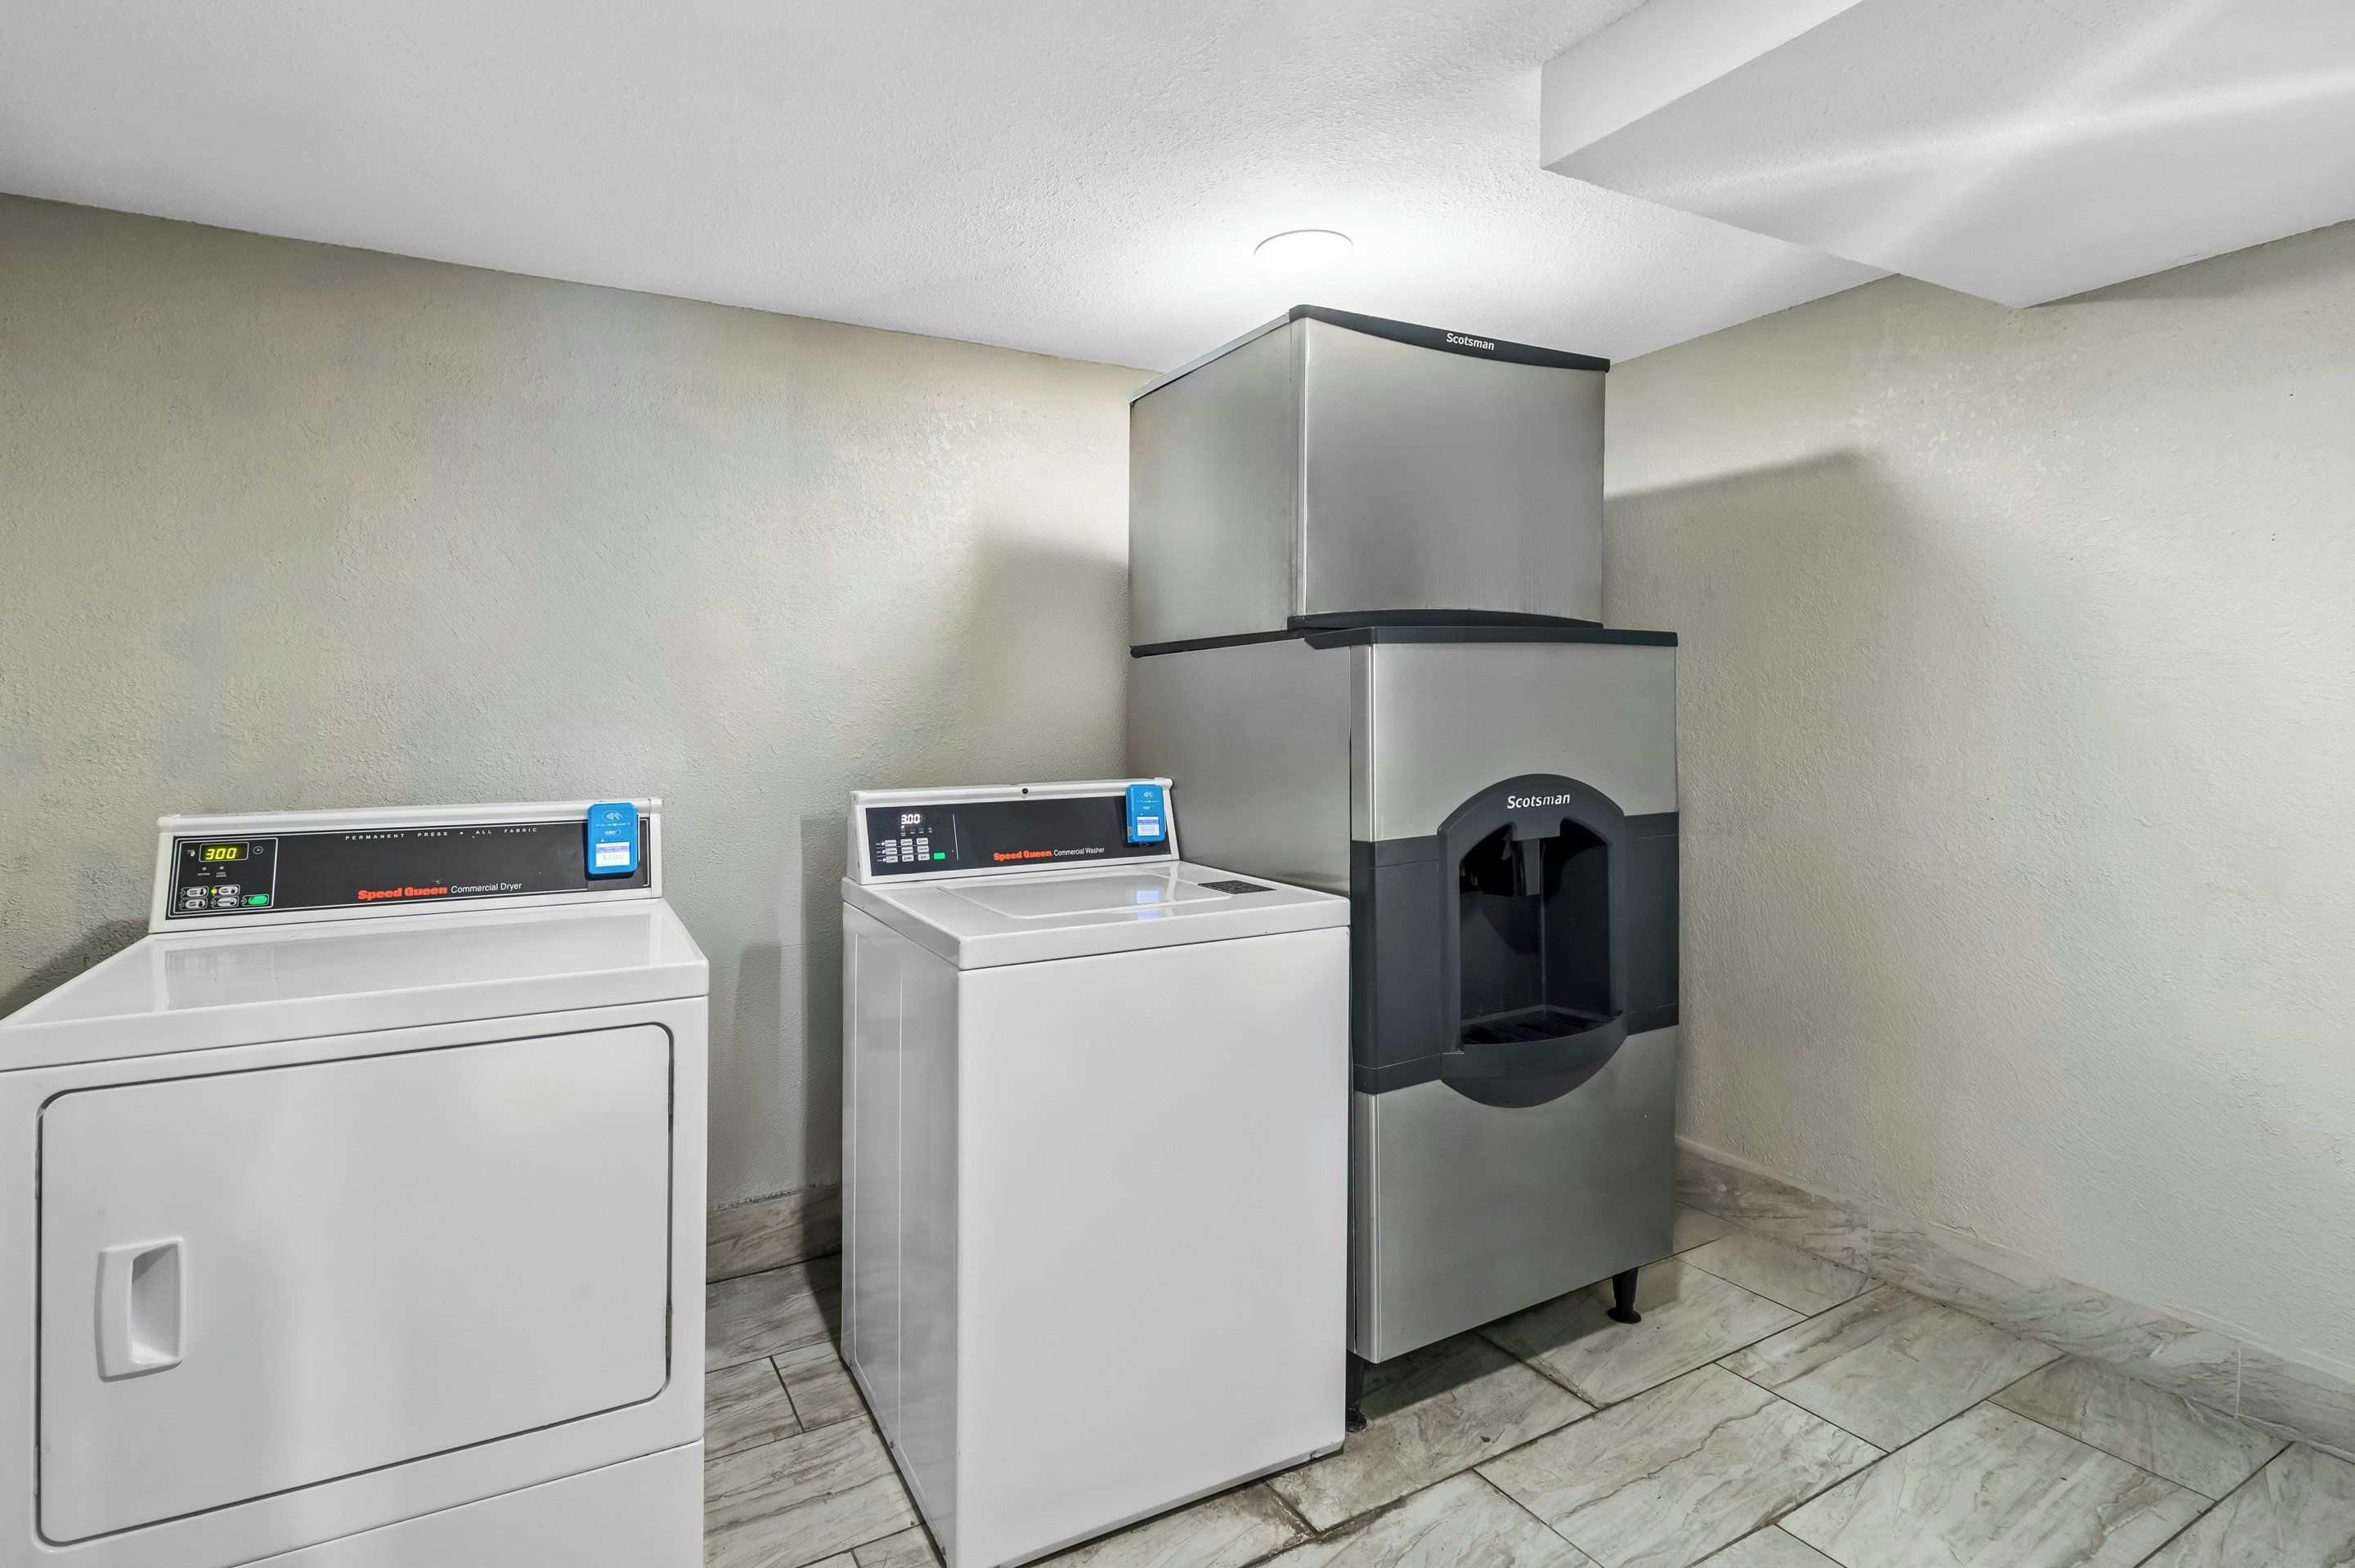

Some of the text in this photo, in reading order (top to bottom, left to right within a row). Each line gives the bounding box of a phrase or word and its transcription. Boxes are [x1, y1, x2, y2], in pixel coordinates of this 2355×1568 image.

[1446, 333, 1495, 351] Scotsman
[1506, 794, 1571, 809] Scotsman
[993, 846, 1105, 861] Speed Queen Commercial Washer
[357, 882, 523, 901] Speed Queen Commercial Dryer
